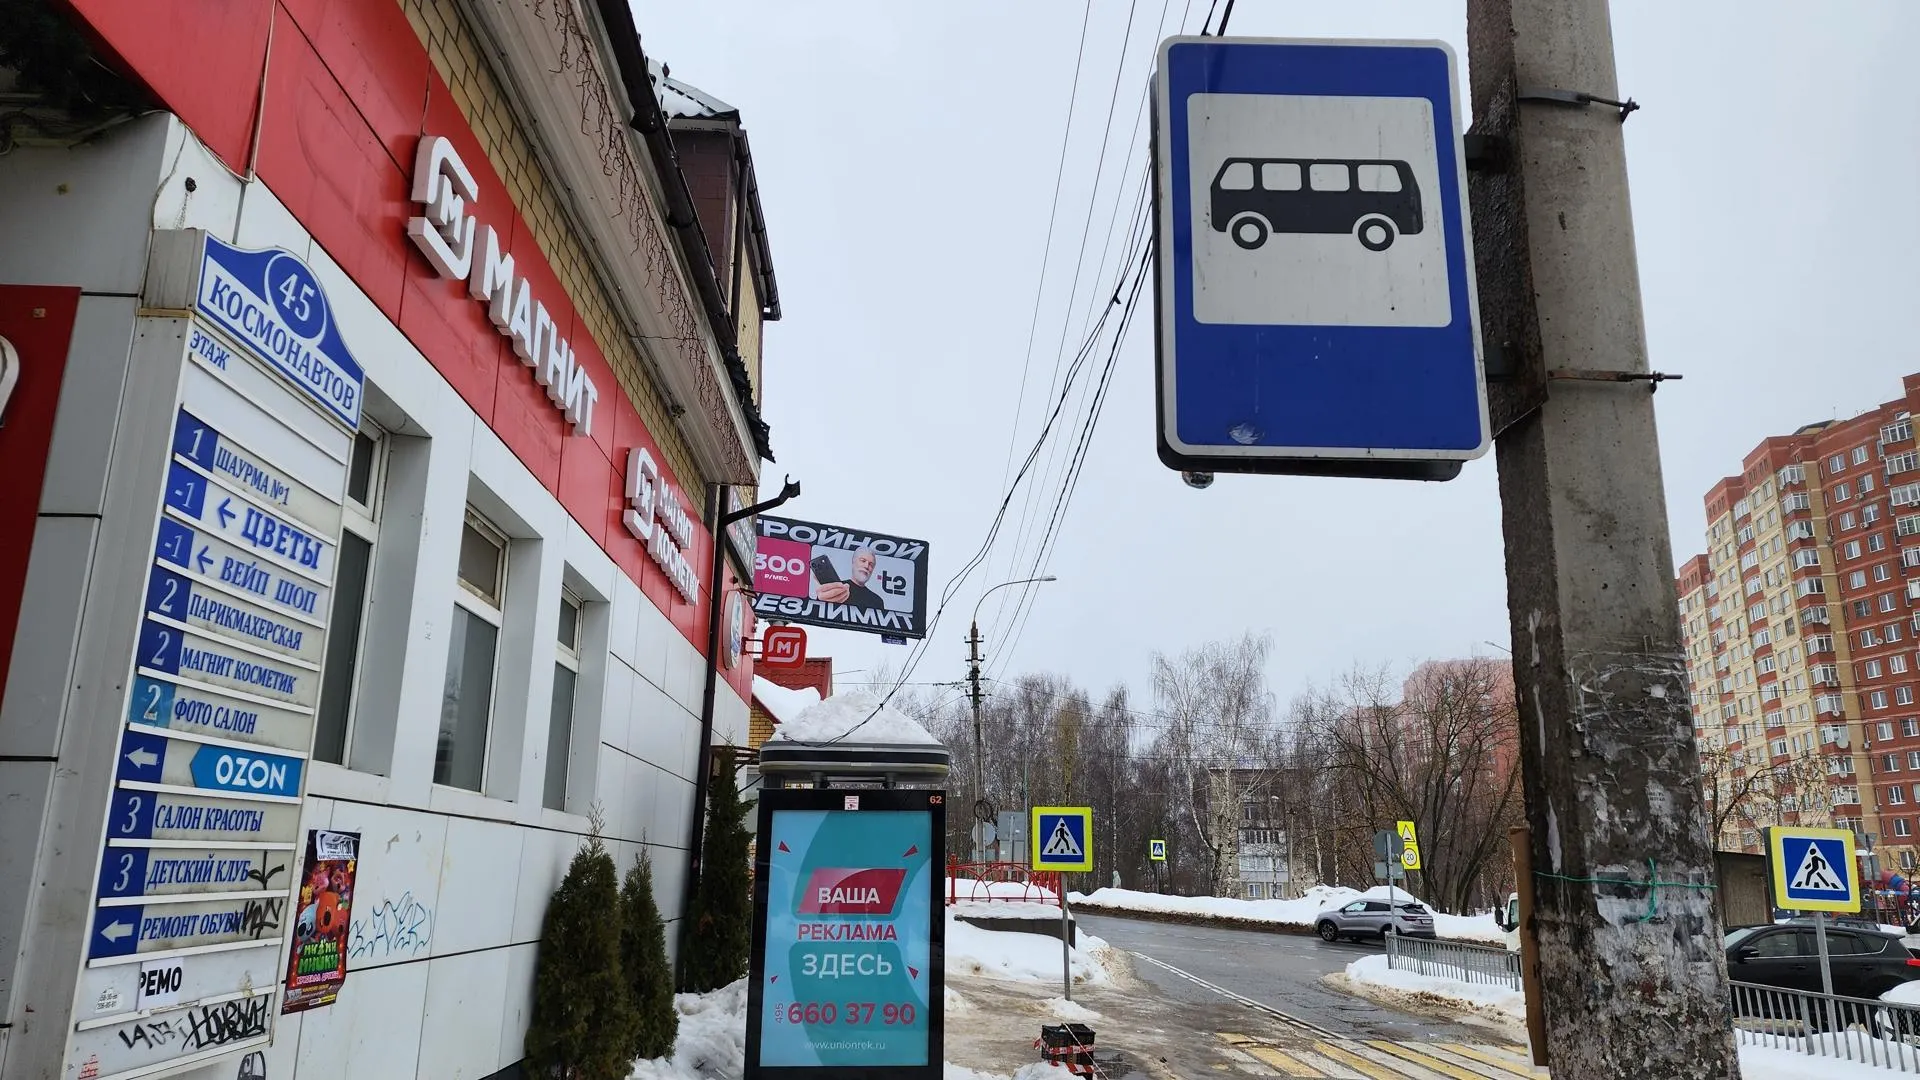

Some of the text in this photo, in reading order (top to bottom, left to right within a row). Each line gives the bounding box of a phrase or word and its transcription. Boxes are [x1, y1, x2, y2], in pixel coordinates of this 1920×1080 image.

[279, 273, 316, 321] 45
[209, 275, 355, 411] КОСМОНАВТОВ
[478, 224, 598, 438] МАГНИТ
[190, 330, 230, 371] ЭТАЖ
[188, 428, 204, 461] 1
[215, 447, 290, 506] ШАУРМА №1
[174, 482, 195, 509] -1
[164, 535, 183, 559] -1
[241, 507, 323, 570] ЦВЕТЫ
[756, 518, 925, 561] РОЙНОЙ
[755, 553, 806, 575] 300
[158, 578, 178, 613] 2
[220, 556, 318, 614] ВЕЙП ШОП
[881, 570, 907, 596] t2
[189, 593, 303, 651] ПАРИКМАХЕРСКАЯ
[752, 593, 913, 630] ЕЗЛИМИТ
[151, 630, 171, 666] 2
[180, 647, 297, 694] МАГНИТ КОСМЕТИК
[143, 684, 161, 721] 2
[174, 697, 258, 734] ФОТО САЛОН
[215, 754, 287, 790] OZON
[121, 796, 142, 834] 3
[929, 795, 942, 804] 62
[154, 804, 265, 832] САЛОН КРАСОТЫ
[113, 853, 134, 892] 3
[146, 853, 251, 890] ДЕТСКИЙ КЛУБ
[1406, 853, 1415, 861] 20
[818, 887, 881, 904] ВАША
[140, 914, 201, 941] РЕМОНТ
[797, 923, 898, 941] РЕКЛАМА
[801, 953, 893, 978] ЗДЕСЬ
[774, 1003, 784, 1024] 495
[787, 1002, 916, 1025] 660 37 90
